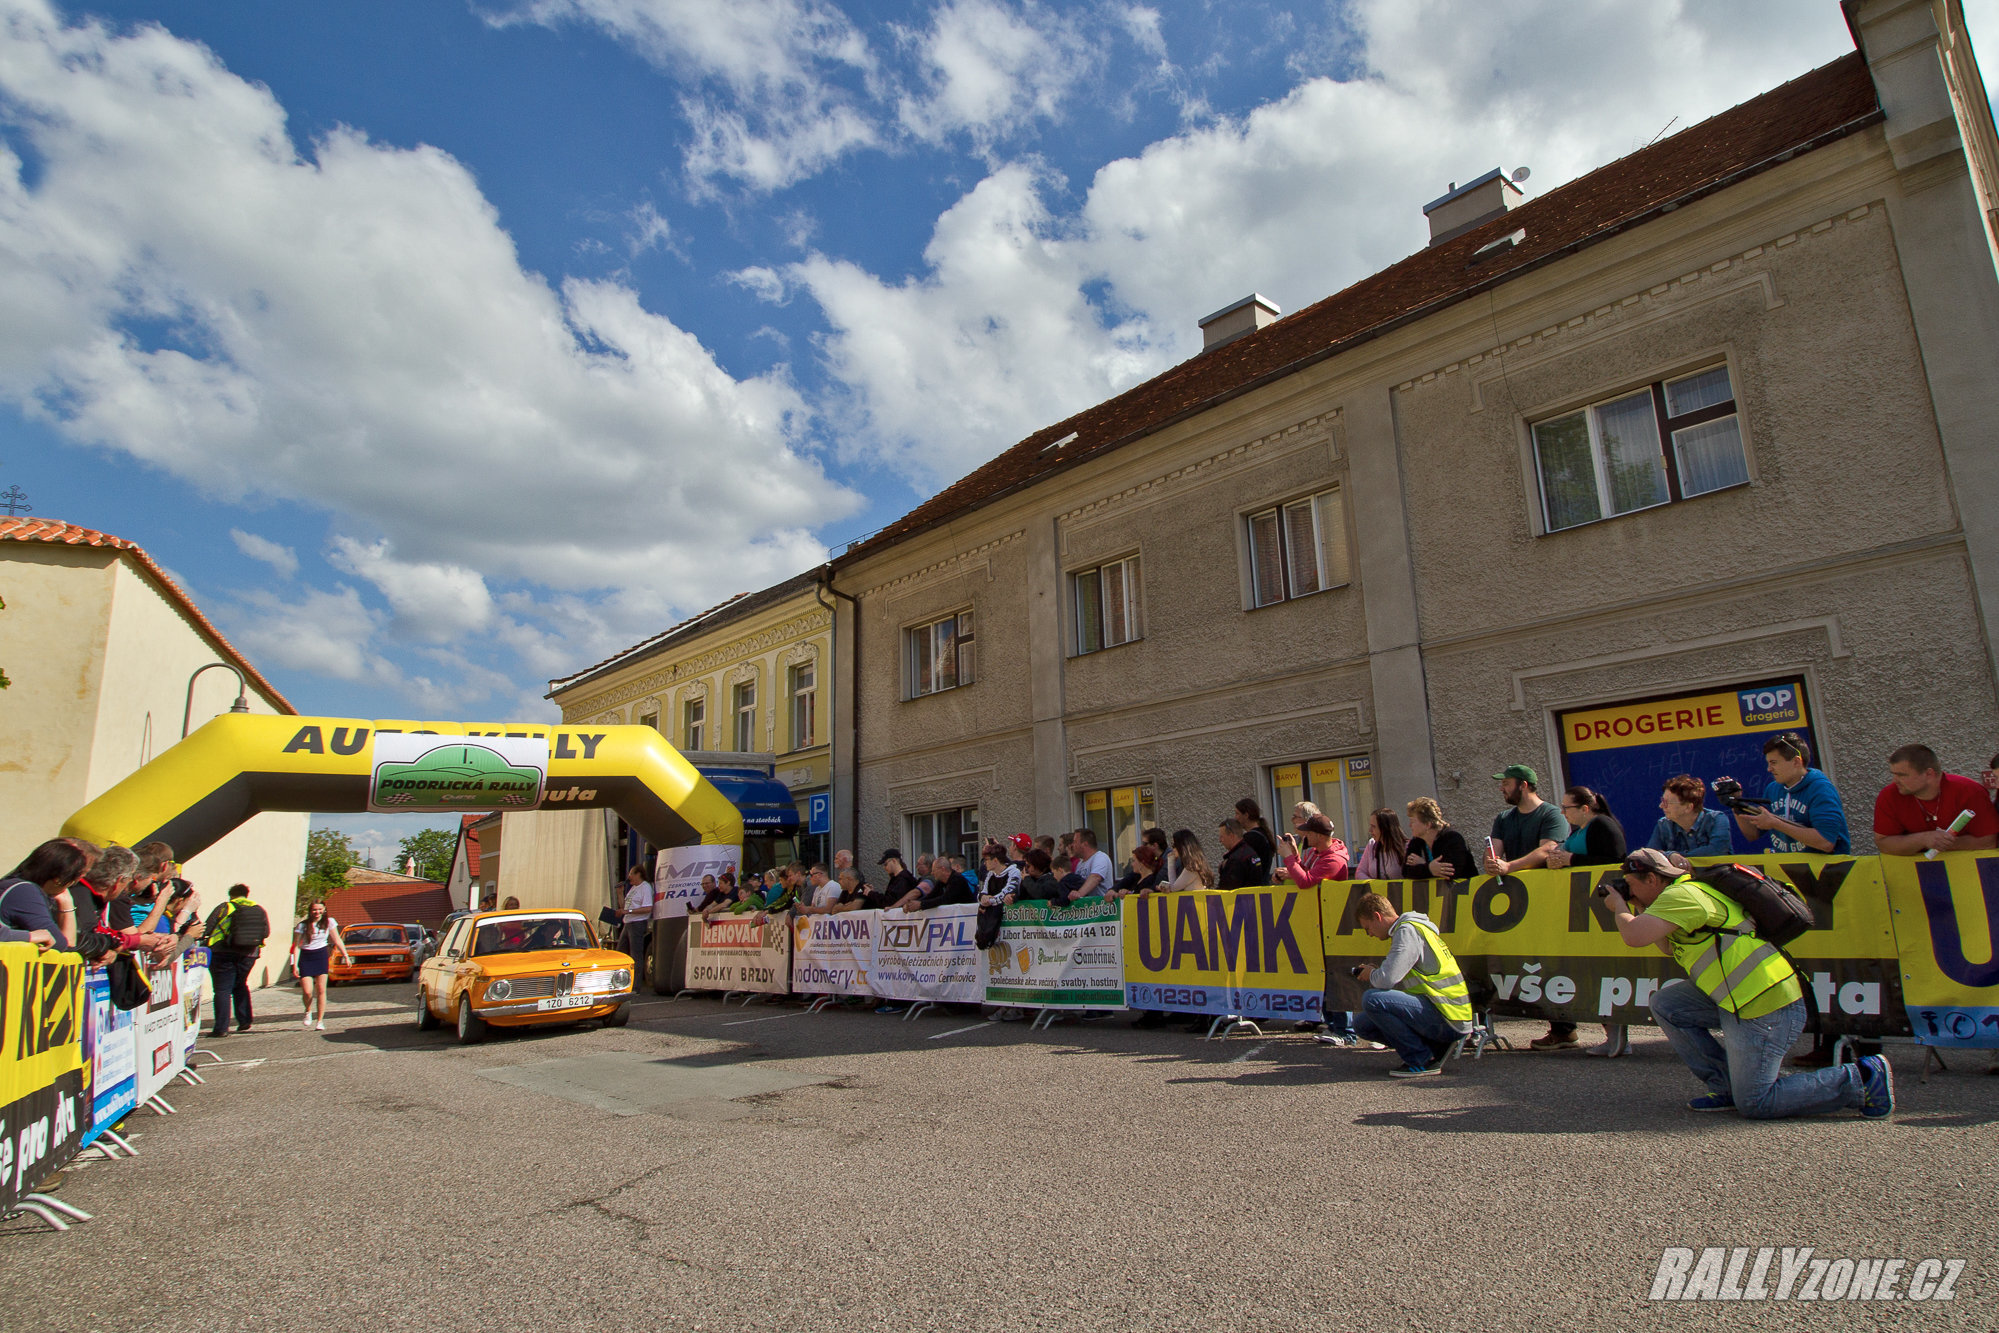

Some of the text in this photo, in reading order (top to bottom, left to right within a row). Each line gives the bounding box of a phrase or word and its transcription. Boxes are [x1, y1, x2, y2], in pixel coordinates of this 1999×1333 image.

[1742, 689, 1792, 711] TOP
[1745, 708, 1795, 722] drogerie
[1573, 705, 1725, 741] DROGERIE
[1350, 759, 1370, 770] TOP
[1275, 773, 1299, 781] BARVY
[1316, 768, 1335, 777] LAKY
[380, 778, 537, 792] PODORLICKÁ RALLY
[813, 799, 826, 822] P
[1040, 908, 1048, 921] u
[811, 919, 871, 940] RENOVA
[883, 918, 973, 952] KOVPAL
[1002, 930, 1020, 940] Libor
[1063, 928, 1078, 938] 604
[1080, 926, 1096, 938] 144
[1100, 926, 1116, 937] 120
[1136, 892, 1309, 975] UAMK
[944, 955, 977, 968] systémů
[693, 966, 775, 983] SPOJKY BRZDY
[1090, 977, 1119, 989] hostiny
[1490, 962, 1576, 1004] vše
[1598, 977, 1687, 1017] pr
[568, 995, 590, 1006] 6212
[1153, 988, 1207, 1006] 1230
[1259, 994, 1322, 1014] 1234
